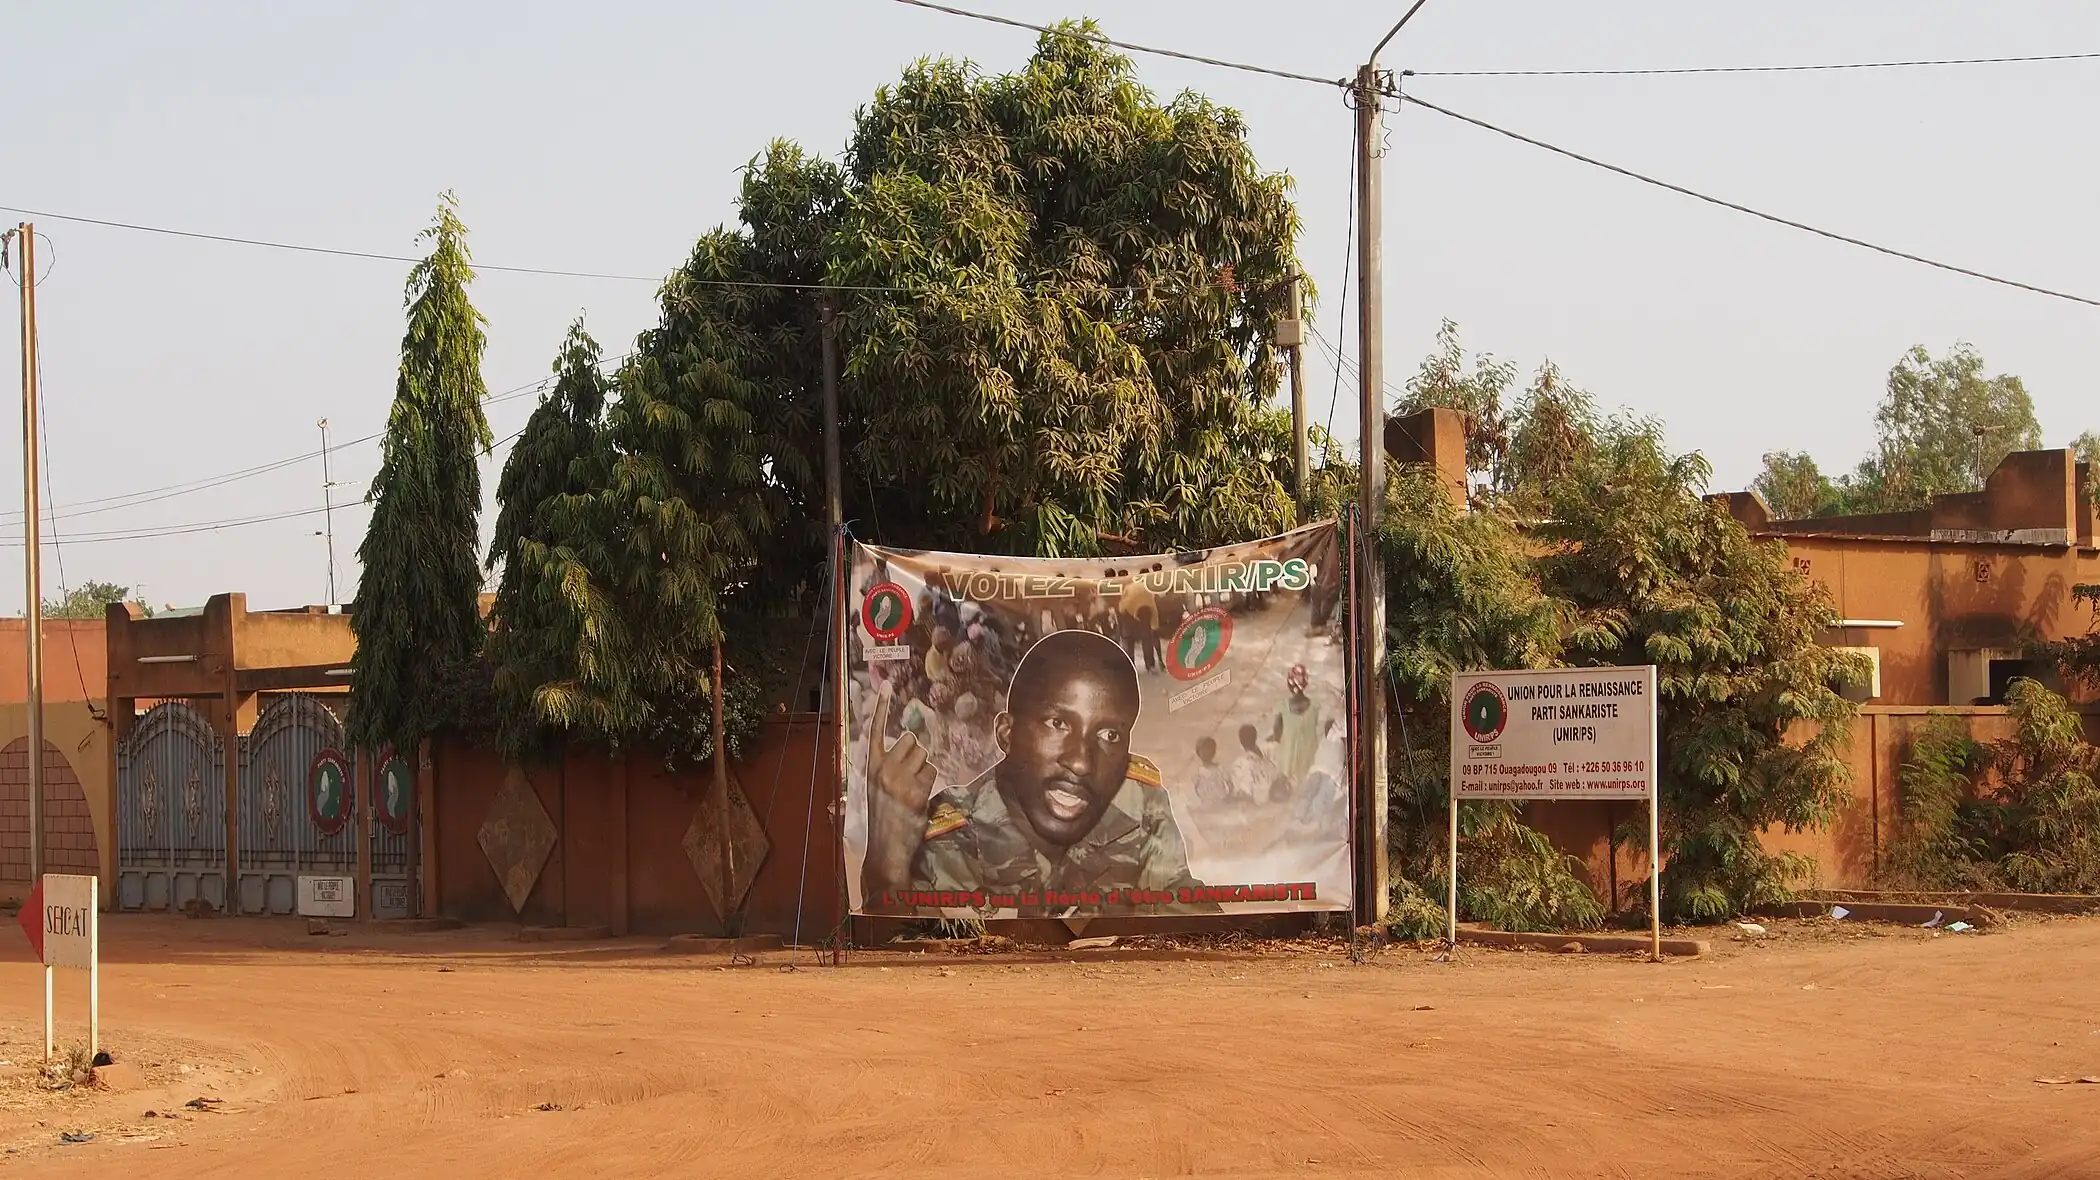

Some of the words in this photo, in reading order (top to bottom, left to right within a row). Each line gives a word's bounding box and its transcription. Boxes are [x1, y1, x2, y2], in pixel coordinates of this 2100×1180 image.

[942, 571, 1075, 601] VOTEZ
[1466, 688, 1476, 700] POUR
[1508, 685, 1535, 700] UNION
[1538, 684, 1562, 699] POUR
[1565, 684, 1576, 698] LA
[1580, 681, 1642, 698] RENAISSANCE
[1531, 706, 1556, 720] PARTI
[1560, 704, 1618, 719] SANKARISTE
[1553, 726, 1596, 745] (UNIR/PS)
[1462, 765, 1471, 775] 09
[1473, 764, 1483, 775] BP
[1484, 764, 1498, 775] 715
[1499, 764, 1546, 777] Ouagadougou
[1548, 763, 1557, 774] 09
[1563, 762, 1574, 773] Tél
[1581, 762, 1600, 773] +226
[1601, 761, 1610, 772] 50
[1612, 761, 1621, 772] 36
[1623, 761, 1632, 772] 96
[1635, 760, 1644, 771] 10
[1461, 781, 1483, 791] E-mail
[1489, 780, 1543, 793] unirps@yahoo.fr
[1549, 779, 1563, 790] Site
[1565, 779, 1580, 790] web
[1587, 778, 1645, 791] www.unirps.org
[882, 891, 895, 906] L
[991, 894, 1015, 906] ou
[1021, 891, 1040, 906] la
[1046, 889, 1100, 906] fierté
[1107, 887, 1119, 904] d
[1178, 882, 1317, 904] SANKARISTE
